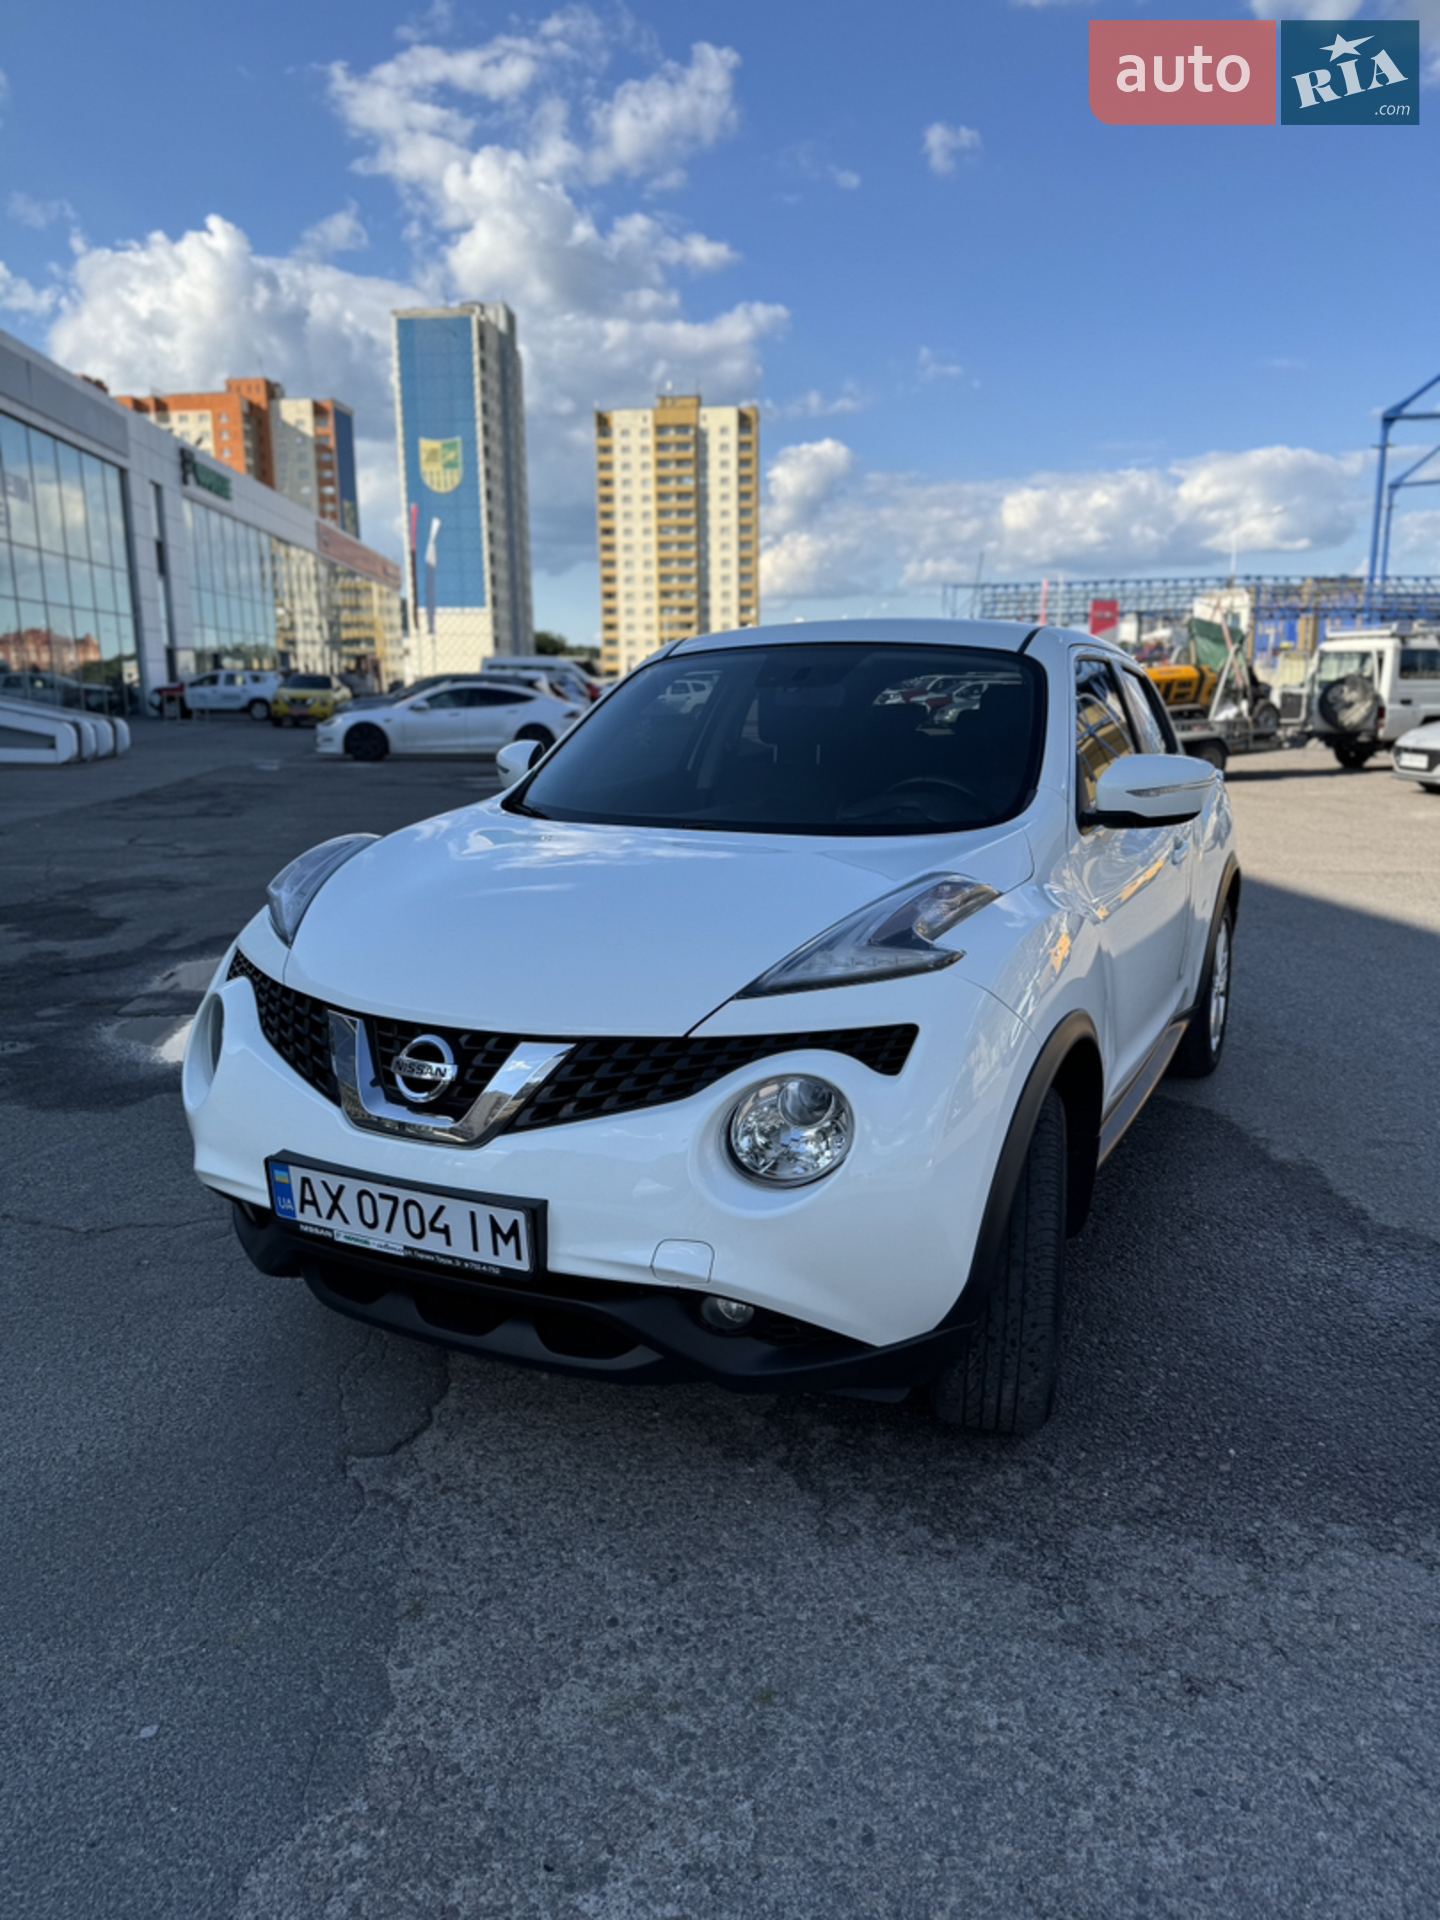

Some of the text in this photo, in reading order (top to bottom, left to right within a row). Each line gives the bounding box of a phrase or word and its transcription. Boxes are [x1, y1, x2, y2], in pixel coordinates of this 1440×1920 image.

[393, 1060, 448, 1079] NISSAN
[277, 1195, 294, 1212] UA
[299, 1176, 523, 1261] AX 0704 IM
